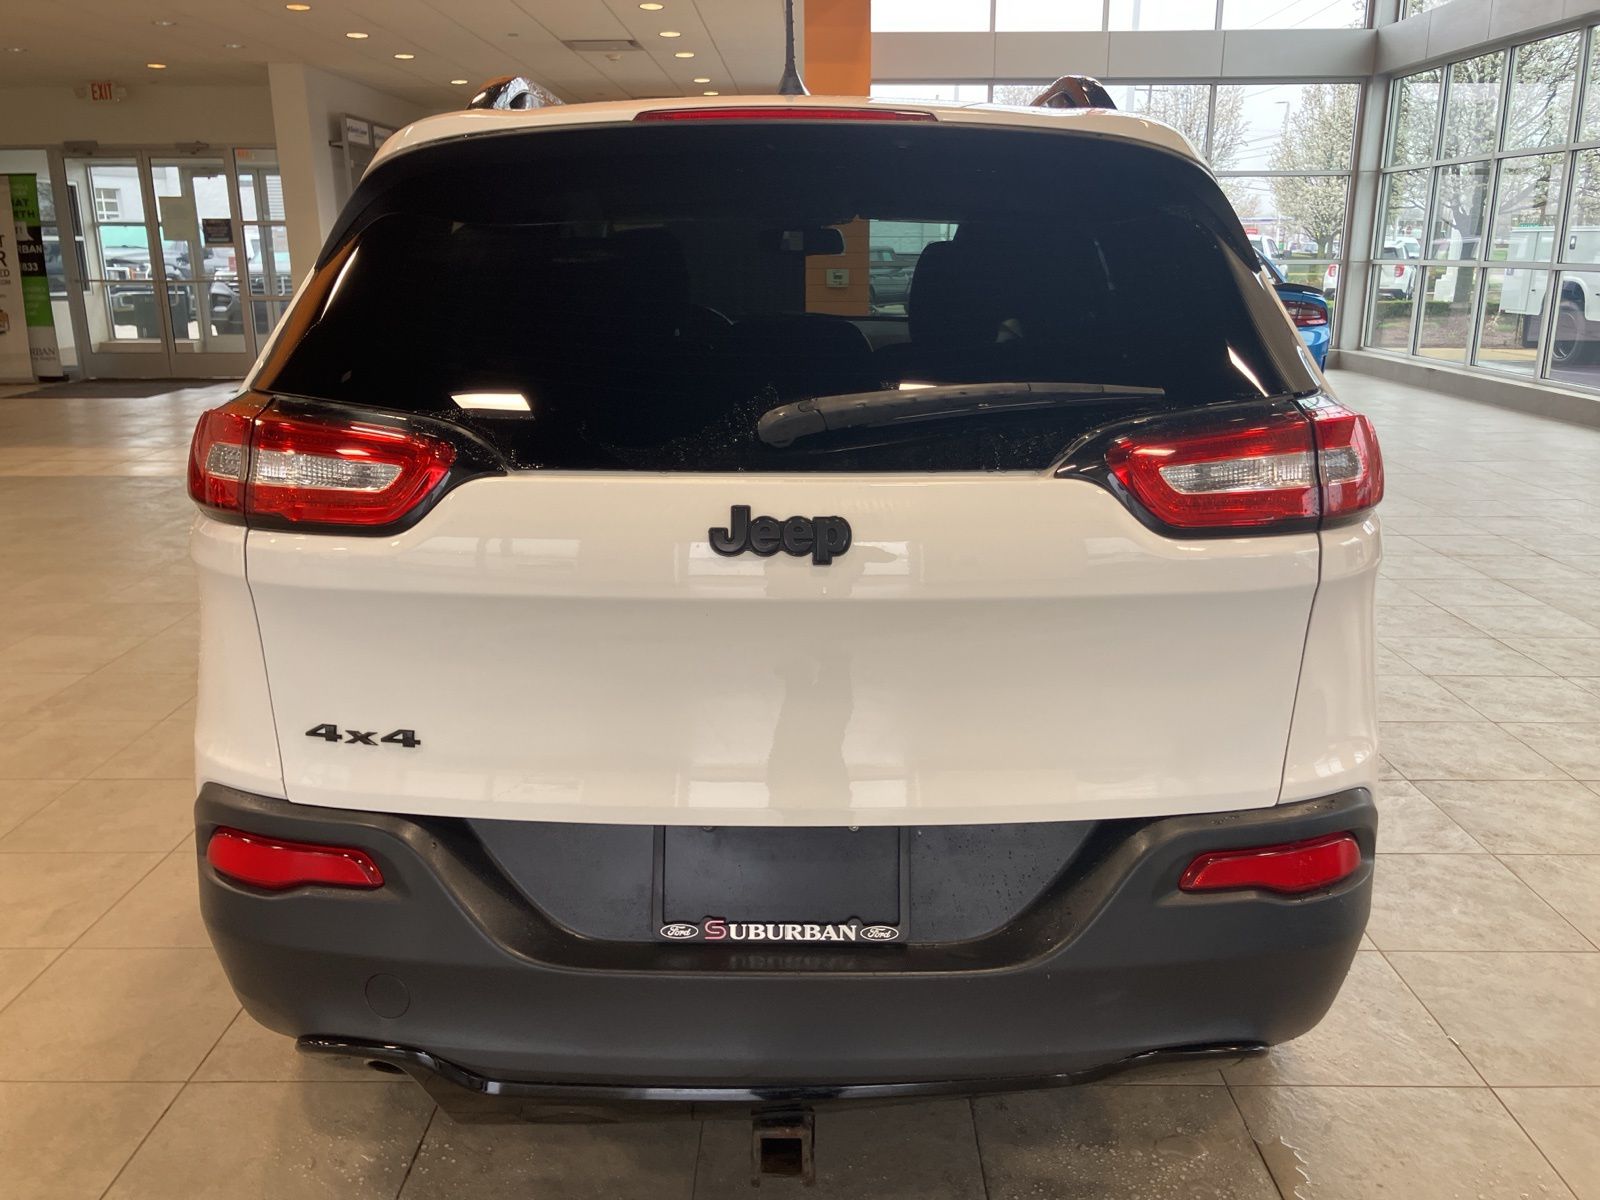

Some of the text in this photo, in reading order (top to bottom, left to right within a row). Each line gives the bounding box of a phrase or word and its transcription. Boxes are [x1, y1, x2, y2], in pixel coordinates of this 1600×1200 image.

[90, 82, 112, 101] EXIT
[708, 504, 853, 566] Jeep
[305, 723, 421, 748] 4x4
[665, 919, 893, 941] Ford SUBURBAN Ford
